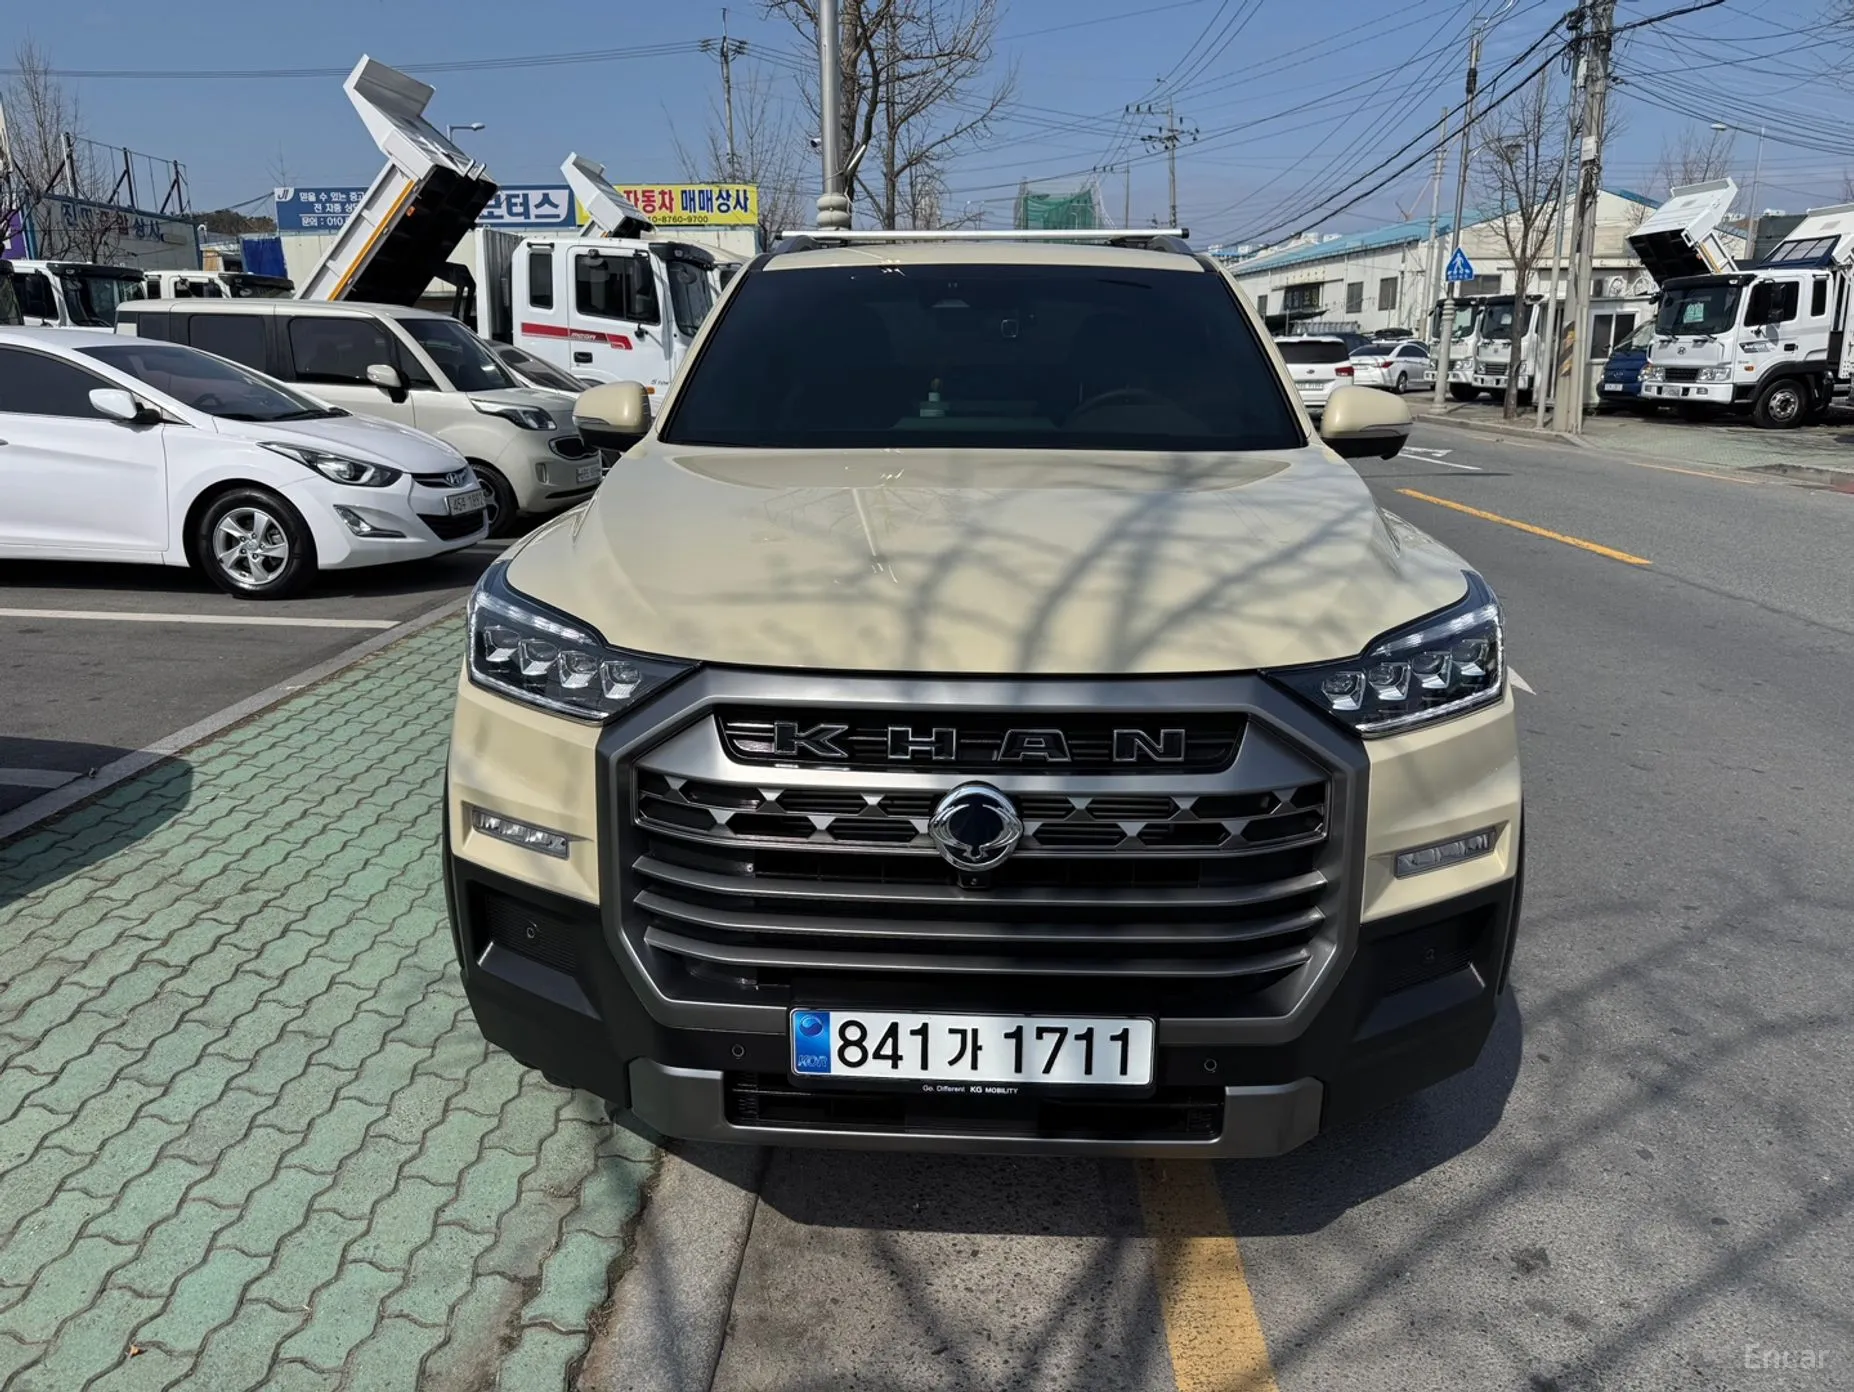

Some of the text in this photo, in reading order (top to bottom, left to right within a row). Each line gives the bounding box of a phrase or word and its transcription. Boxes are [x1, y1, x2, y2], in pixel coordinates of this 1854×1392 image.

[299, 191, 317, 202] 믿을
[319, 191, 328, 202] 수
[330, 191, 347, 202] 있는
[623, 189, 750, 214] 자동차 매매상사
[301, 216, 318, 227] 문의
[774, 720, 1187, 763] KHAN
[837, 1019, 1131, 1077] 841가 1711
[798, 1054, 828, 1068] KOR
[936, 1085, 966, 1093] Different
[969, 1085, 983, 1094] KG
[985, 1086, 1019, 1095] MOBILITY
